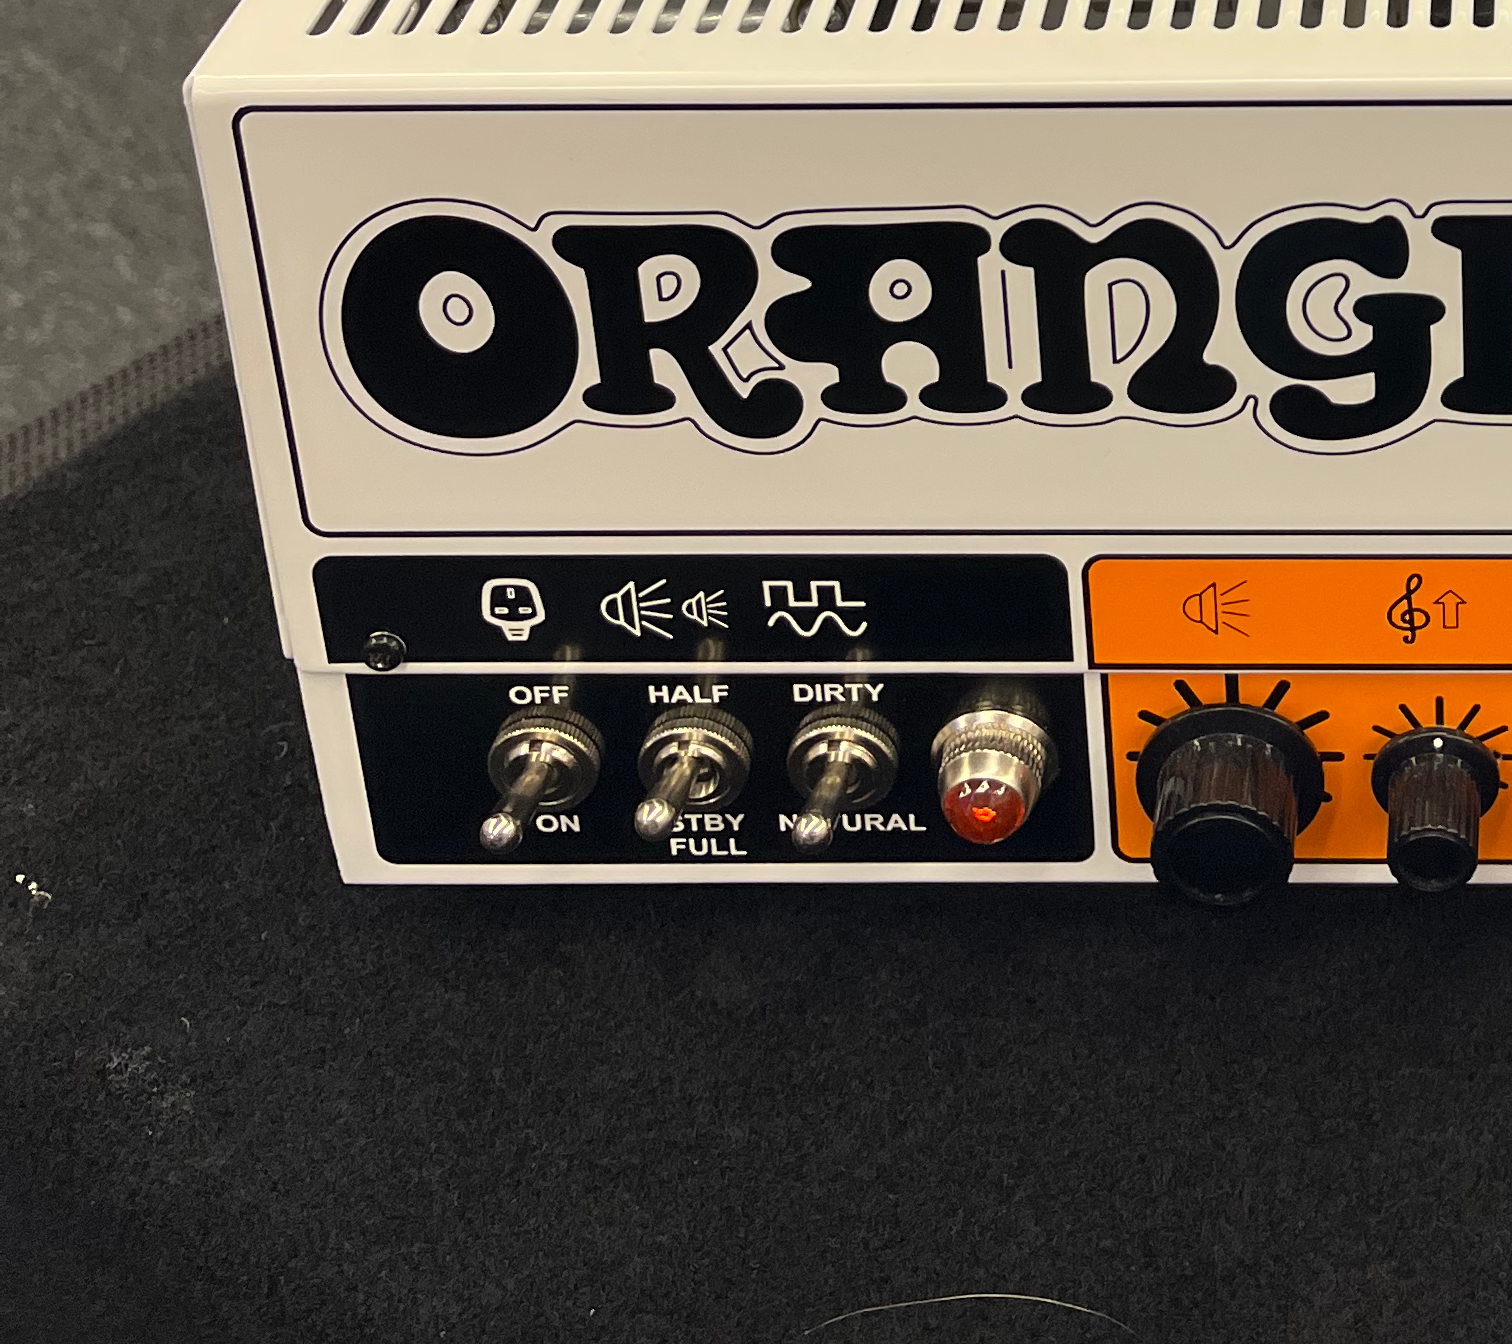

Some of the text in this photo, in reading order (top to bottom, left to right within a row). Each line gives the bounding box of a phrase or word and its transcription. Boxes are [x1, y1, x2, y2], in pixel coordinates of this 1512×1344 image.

[508, 685, 569, 705] OFF
[648, 684, 729, 704] HALF
[793, 682, 884, 703] DIRTY
[535, 813, 581, 834] ON
[778, 813, 927, 833] NURAL
[669, 837, 748, 857] FULL
